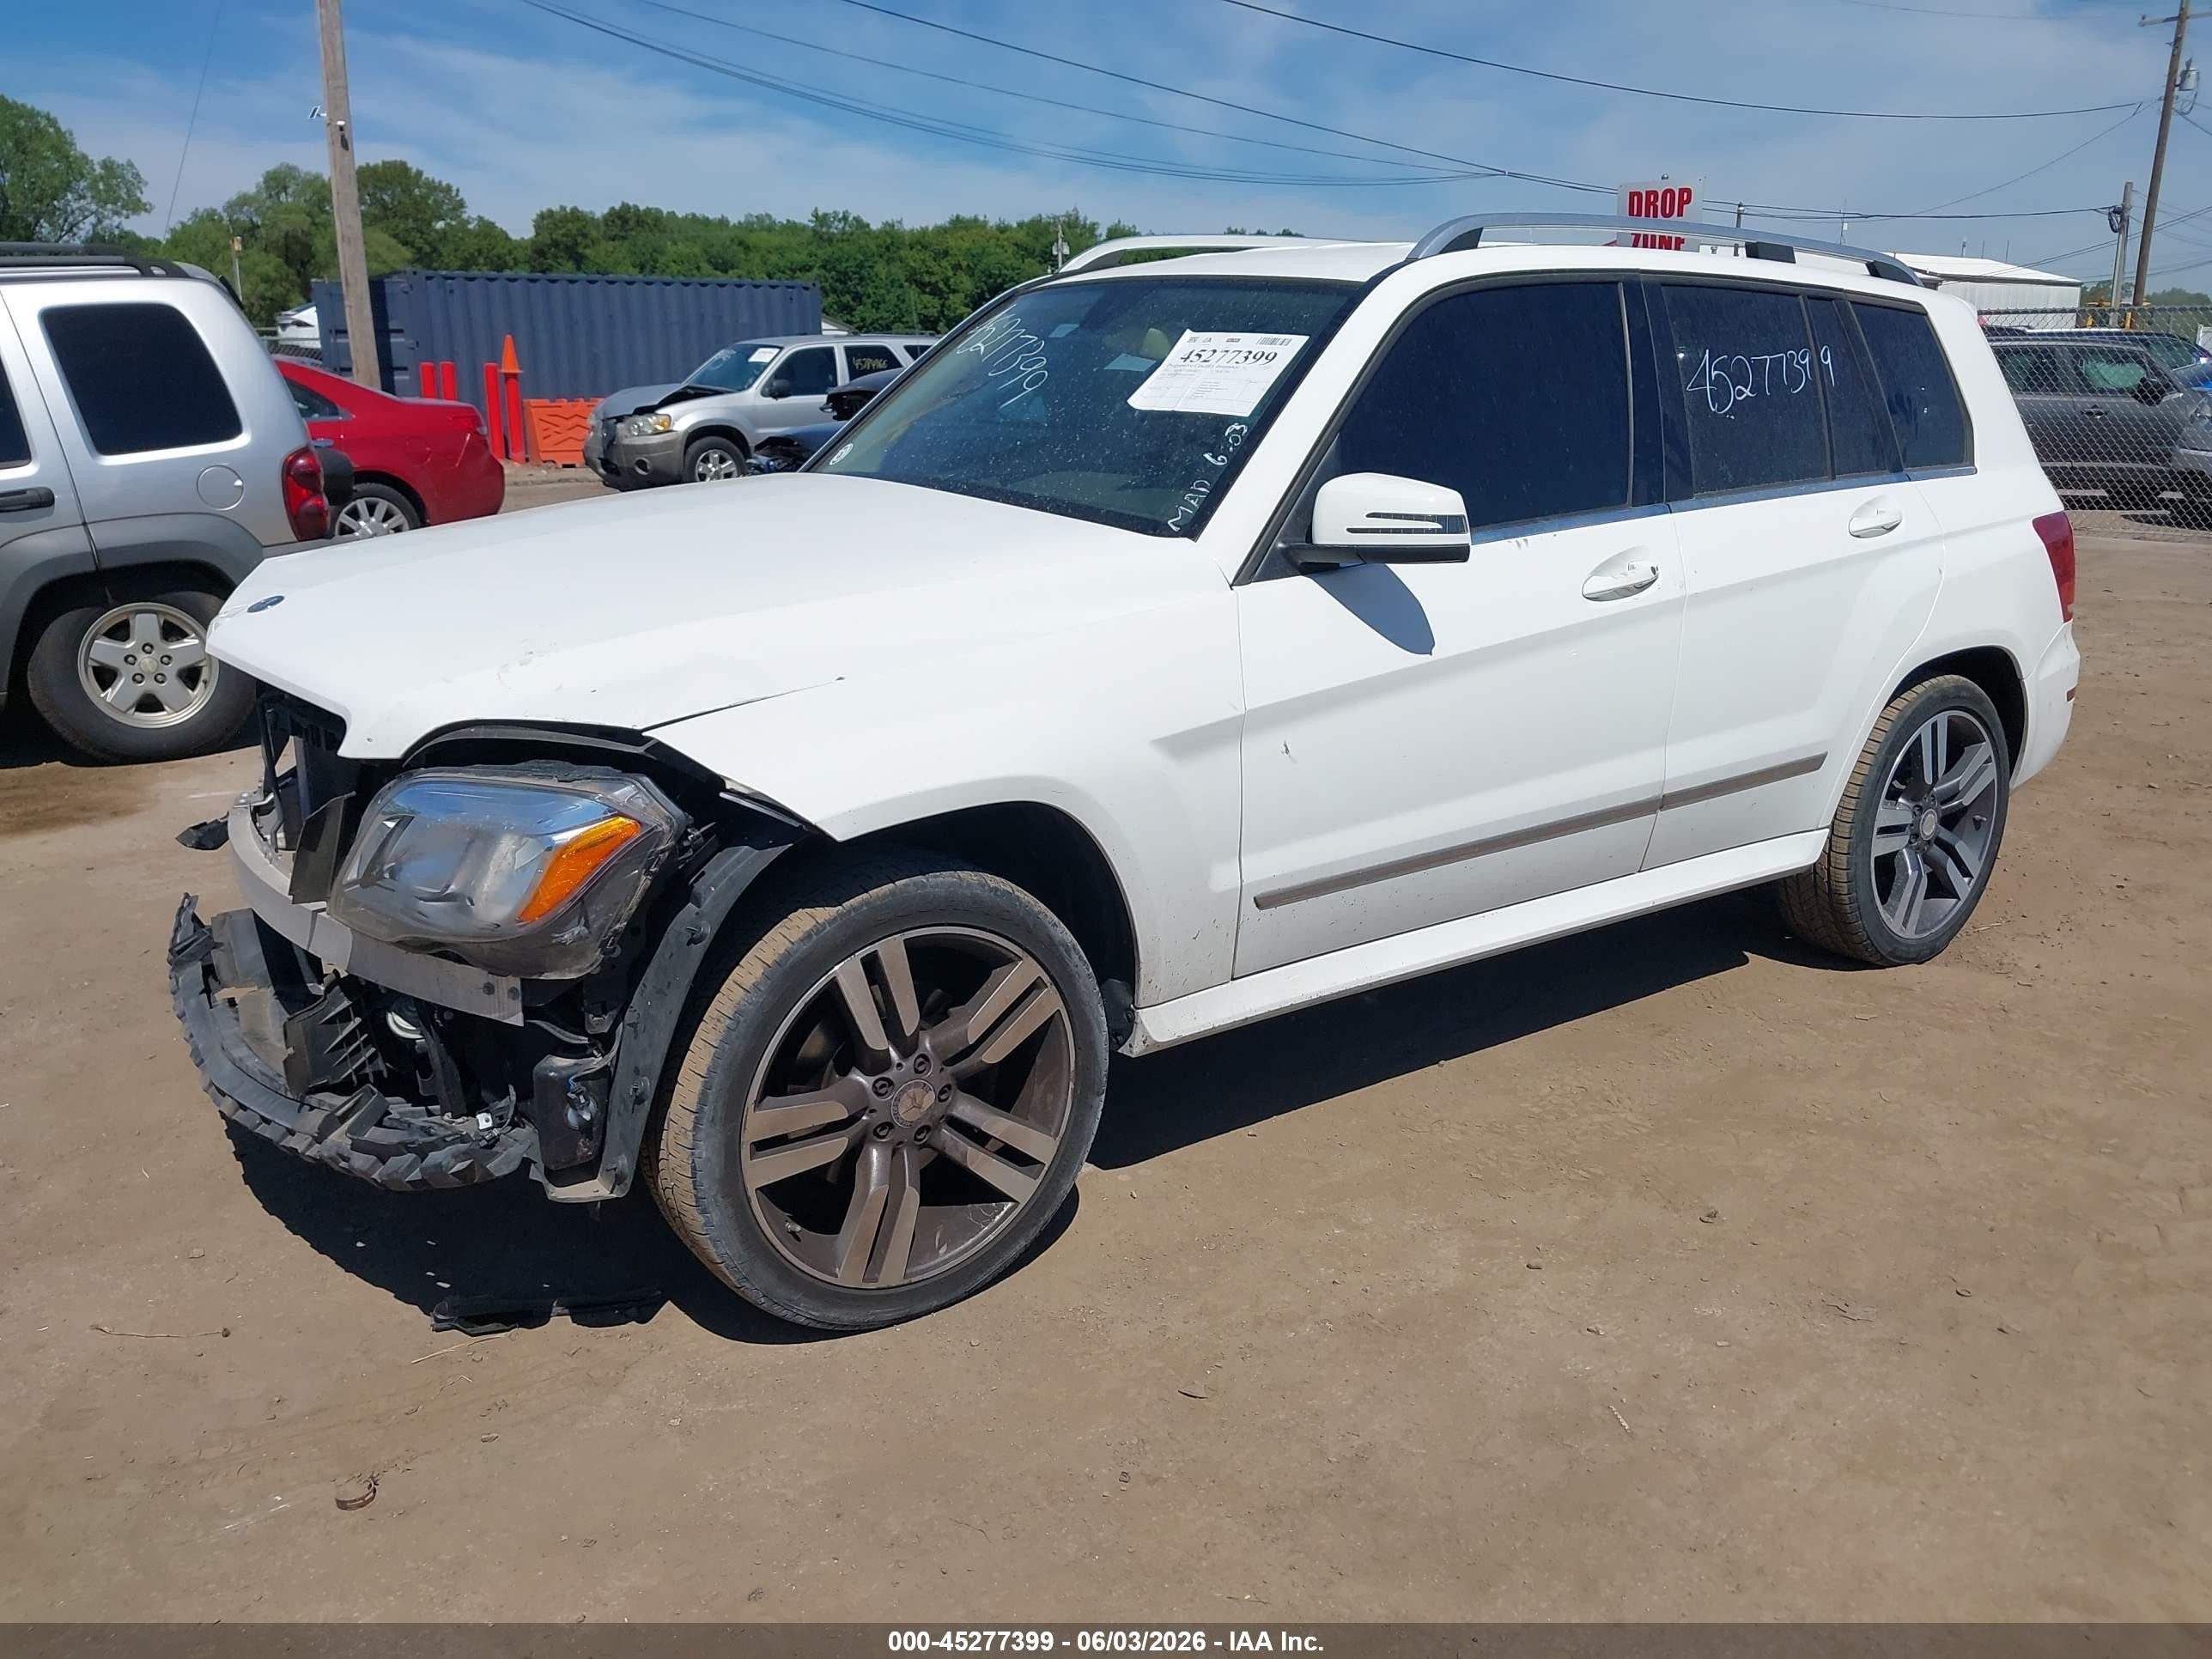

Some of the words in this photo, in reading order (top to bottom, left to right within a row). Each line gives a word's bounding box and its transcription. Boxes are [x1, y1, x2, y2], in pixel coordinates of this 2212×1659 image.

[1628, 187, 1692, 218] DROP
[1180, 349, 1278, 366] 45277399
[1686, 345, 1835, 414] 45277399
[1168, 478, 1211, 532] MAD
